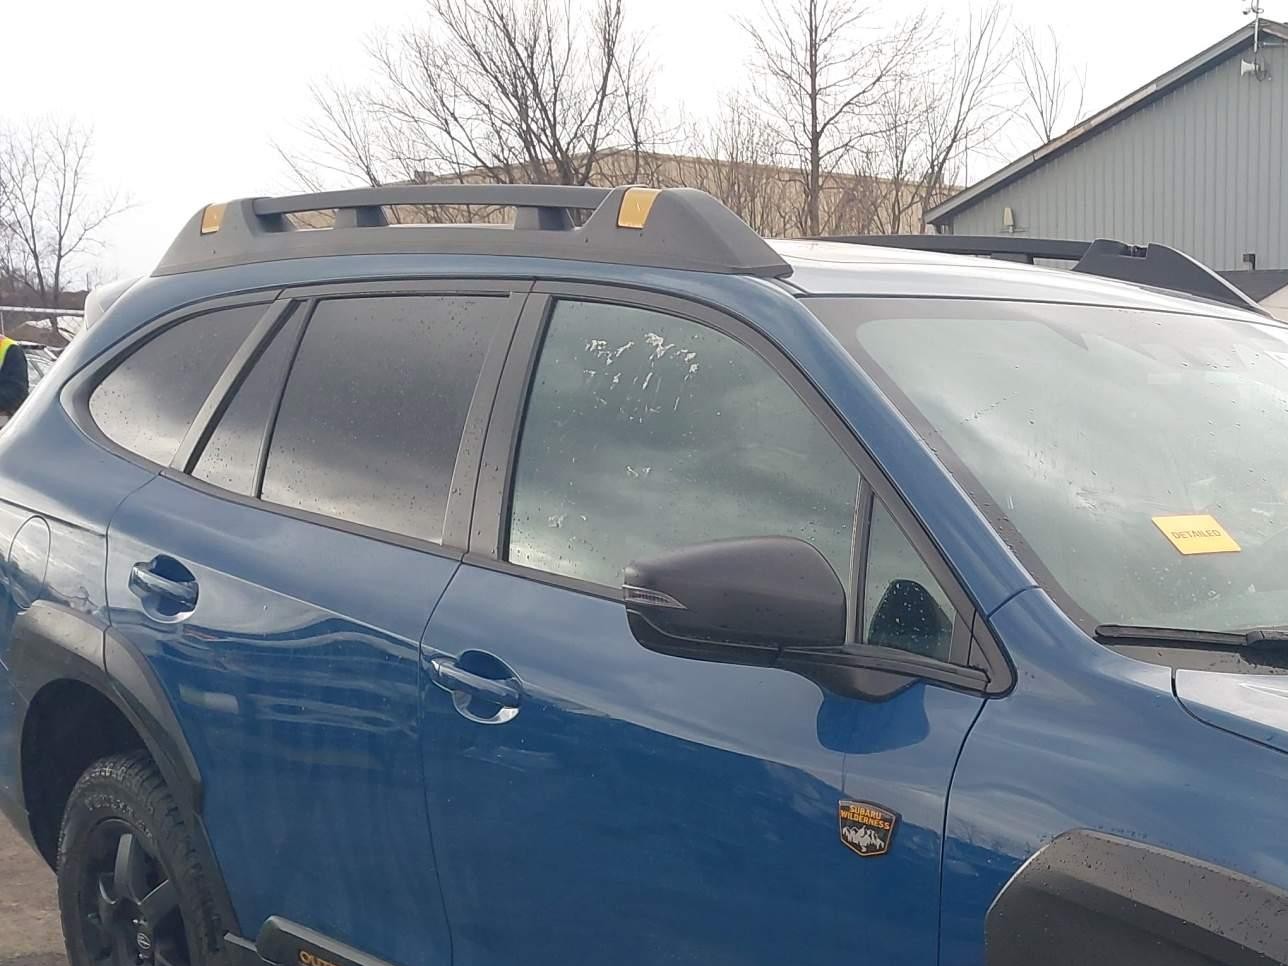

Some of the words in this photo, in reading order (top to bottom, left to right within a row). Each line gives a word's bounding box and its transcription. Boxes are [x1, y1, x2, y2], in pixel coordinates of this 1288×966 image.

[1170, 529, 1221, 539] DETAILED
[849, 804, 882, 819] SUBARU
[840, 809, 890, 830] WILDERNESS
